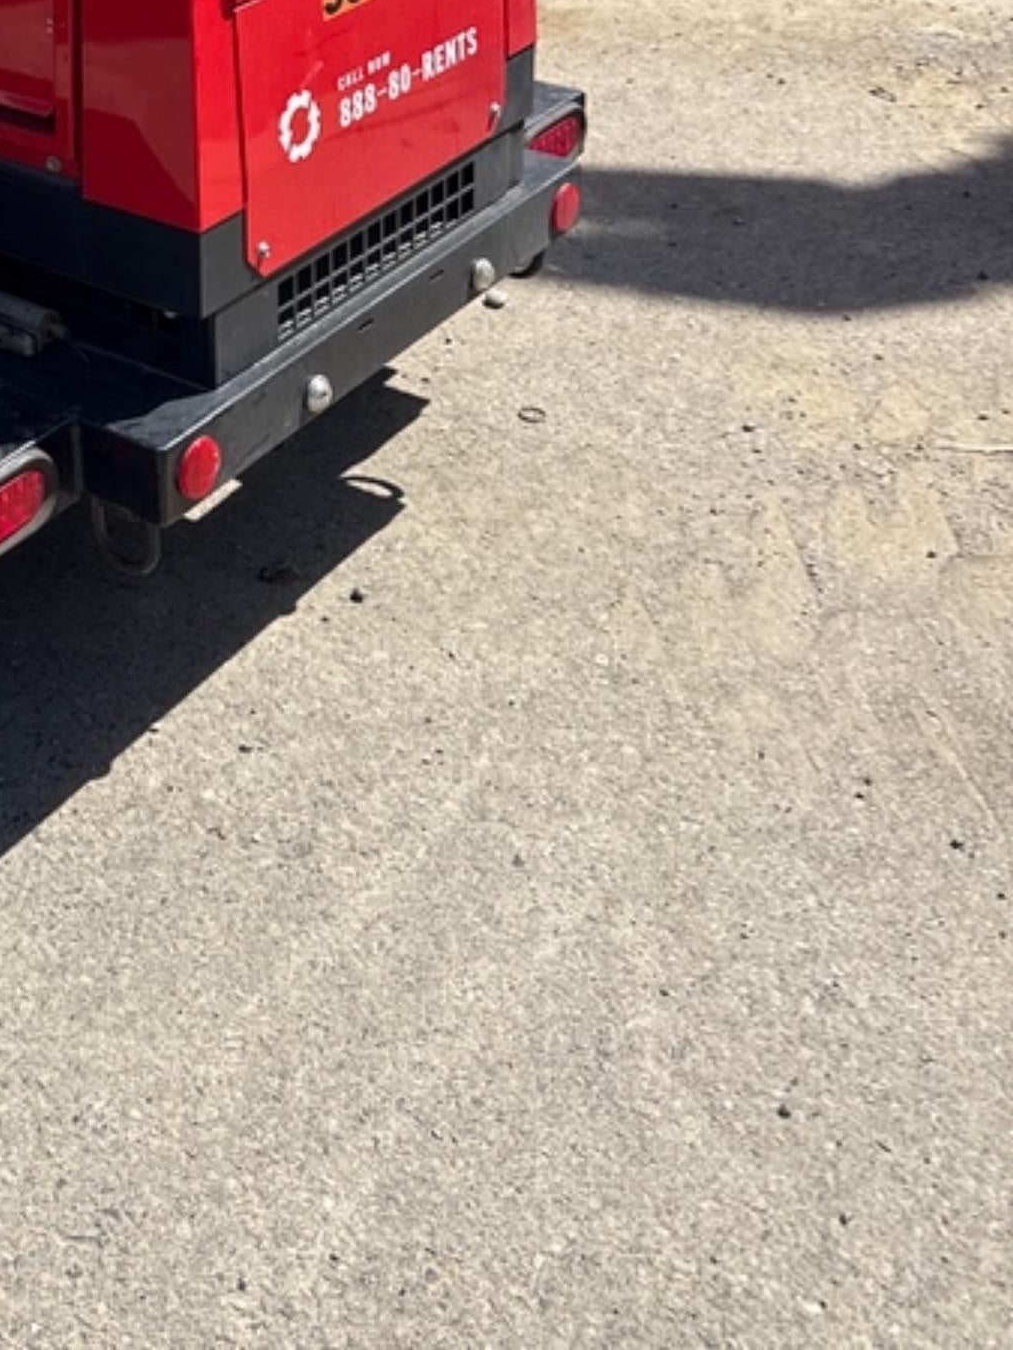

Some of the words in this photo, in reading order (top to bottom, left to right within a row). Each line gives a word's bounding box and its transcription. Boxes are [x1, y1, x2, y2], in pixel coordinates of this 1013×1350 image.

[337, 65, 365, 91] CALL
[367, 50, 391, 75] NOW
[340, 26, 478, 128] 888-80-RENTS
